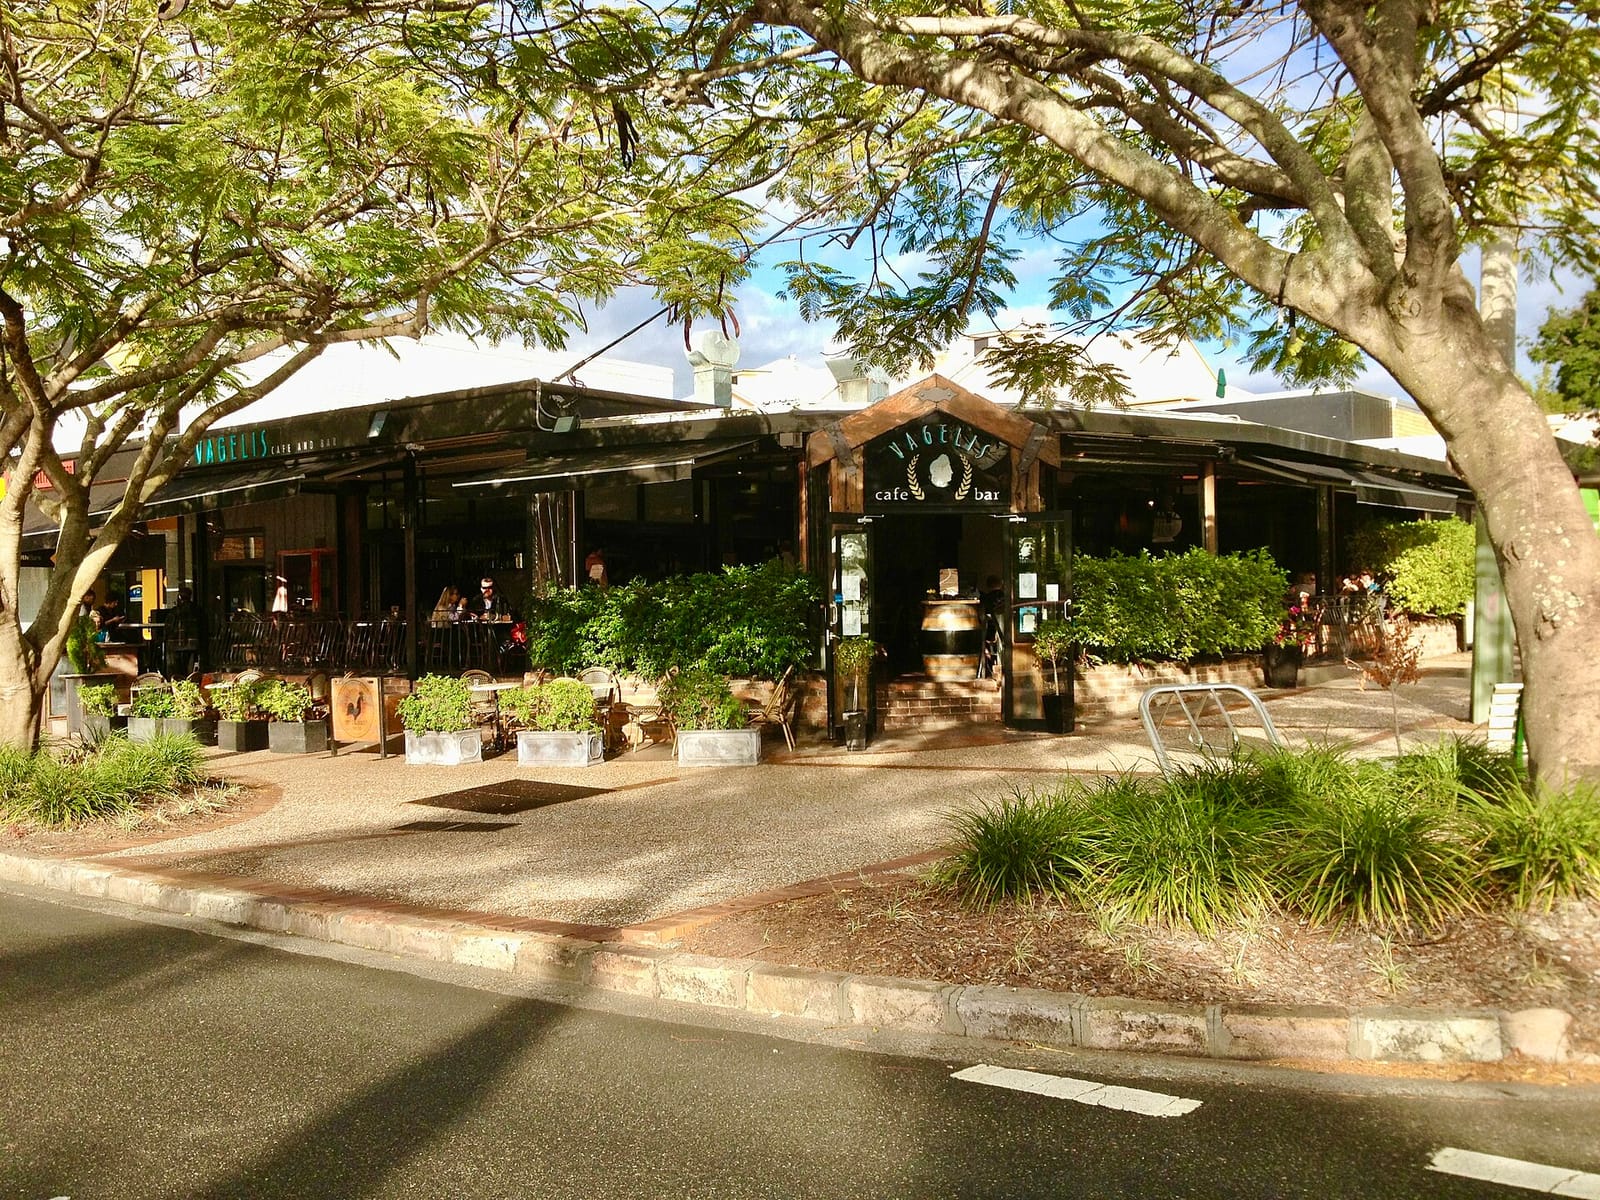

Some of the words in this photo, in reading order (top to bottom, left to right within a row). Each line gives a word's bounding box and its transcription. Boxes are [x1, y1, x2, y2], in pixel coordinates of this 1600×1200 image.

[194, 429, 268, 465] VAGELIS
[271, 443, 291, 455] CAFE
[297, 440, 313, 451] AND
[888, 424, 991, 459] VAGELIS
[875, 487, 909, 501] cafe
[974, 488, 1000, 501] bar
